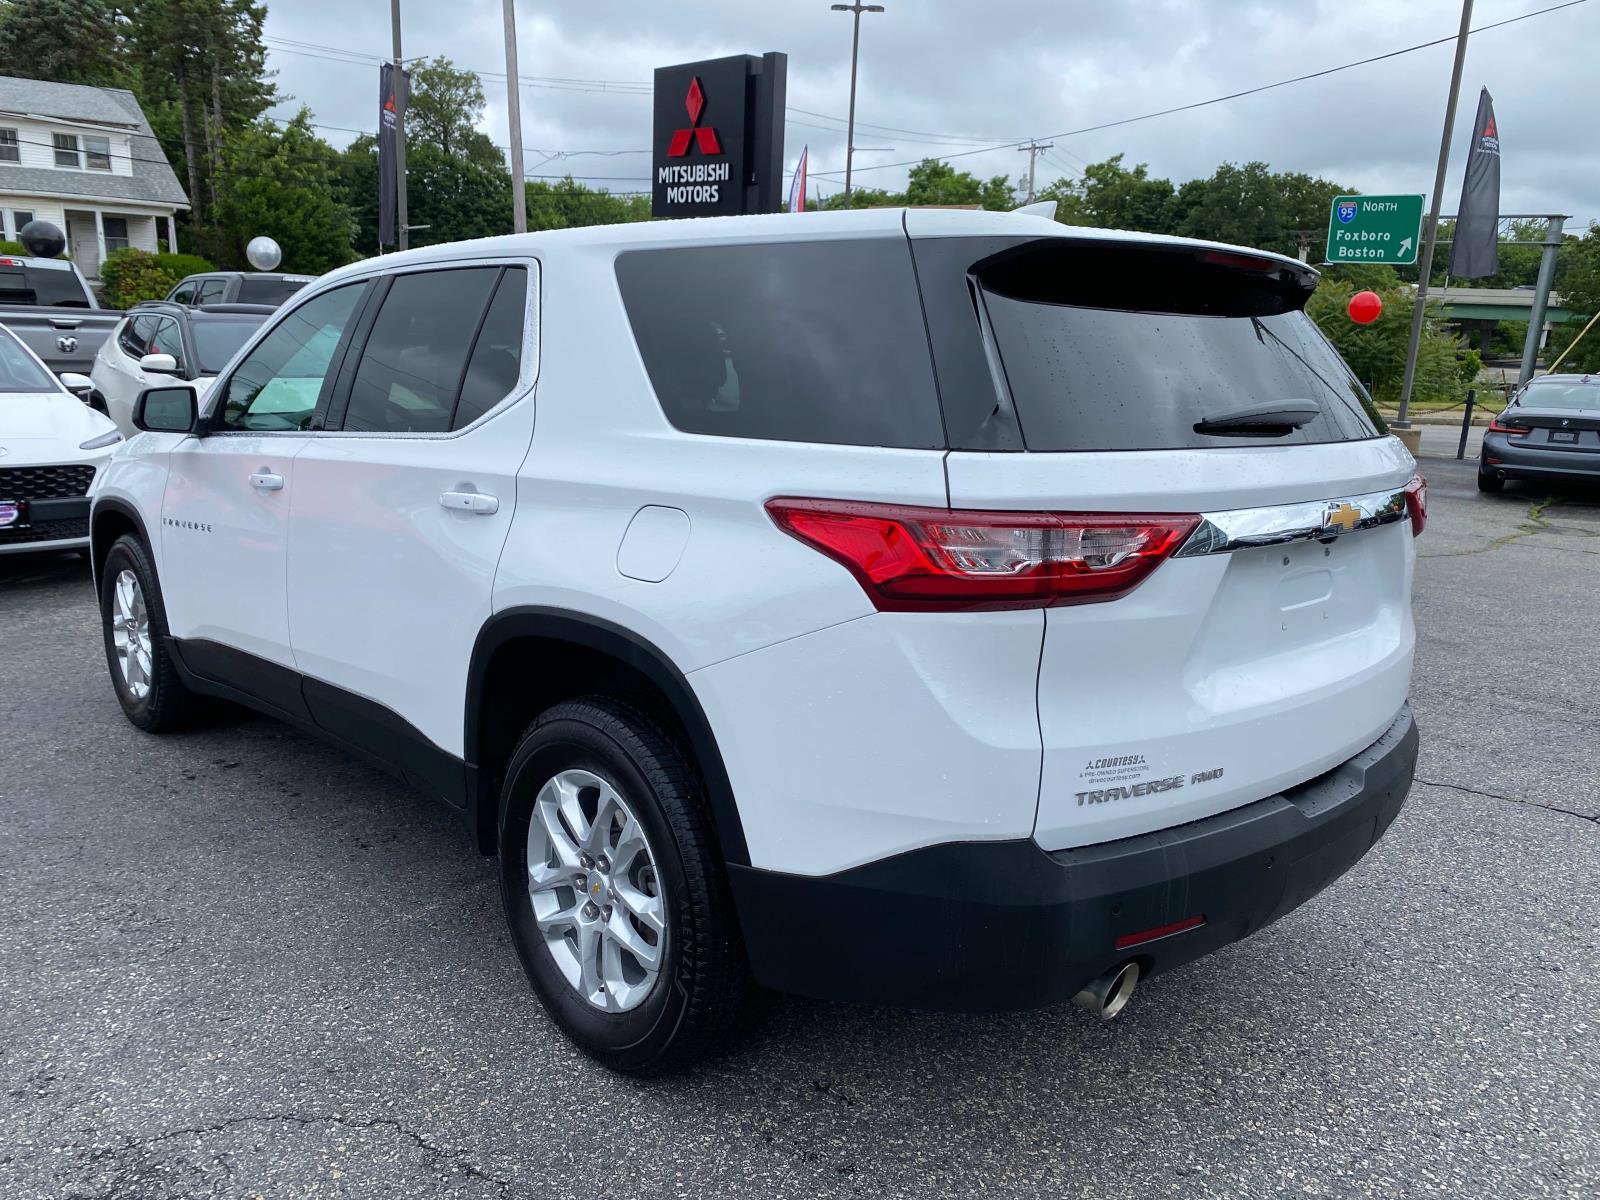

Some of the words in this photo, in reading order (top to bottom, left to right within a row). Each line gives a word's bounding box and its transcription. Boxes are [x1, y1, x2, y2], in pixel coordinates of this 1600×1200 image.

[658, 163, 729, 184] MITSUBISHI
[666, 185, 719, 204] MOTORS
[1341, 207, 1354, 218] 95
[1362, 201, 1398, 212] NORTH
[1336, 229, 1391, 241] Foxboro
[1338, 246, 1385, 258] Boston
[1075, 774, 1185, 806] TRAVERSE
[1191, 768, 1224, 784] AWD
[680, 899, 694, 980] ALENZA
